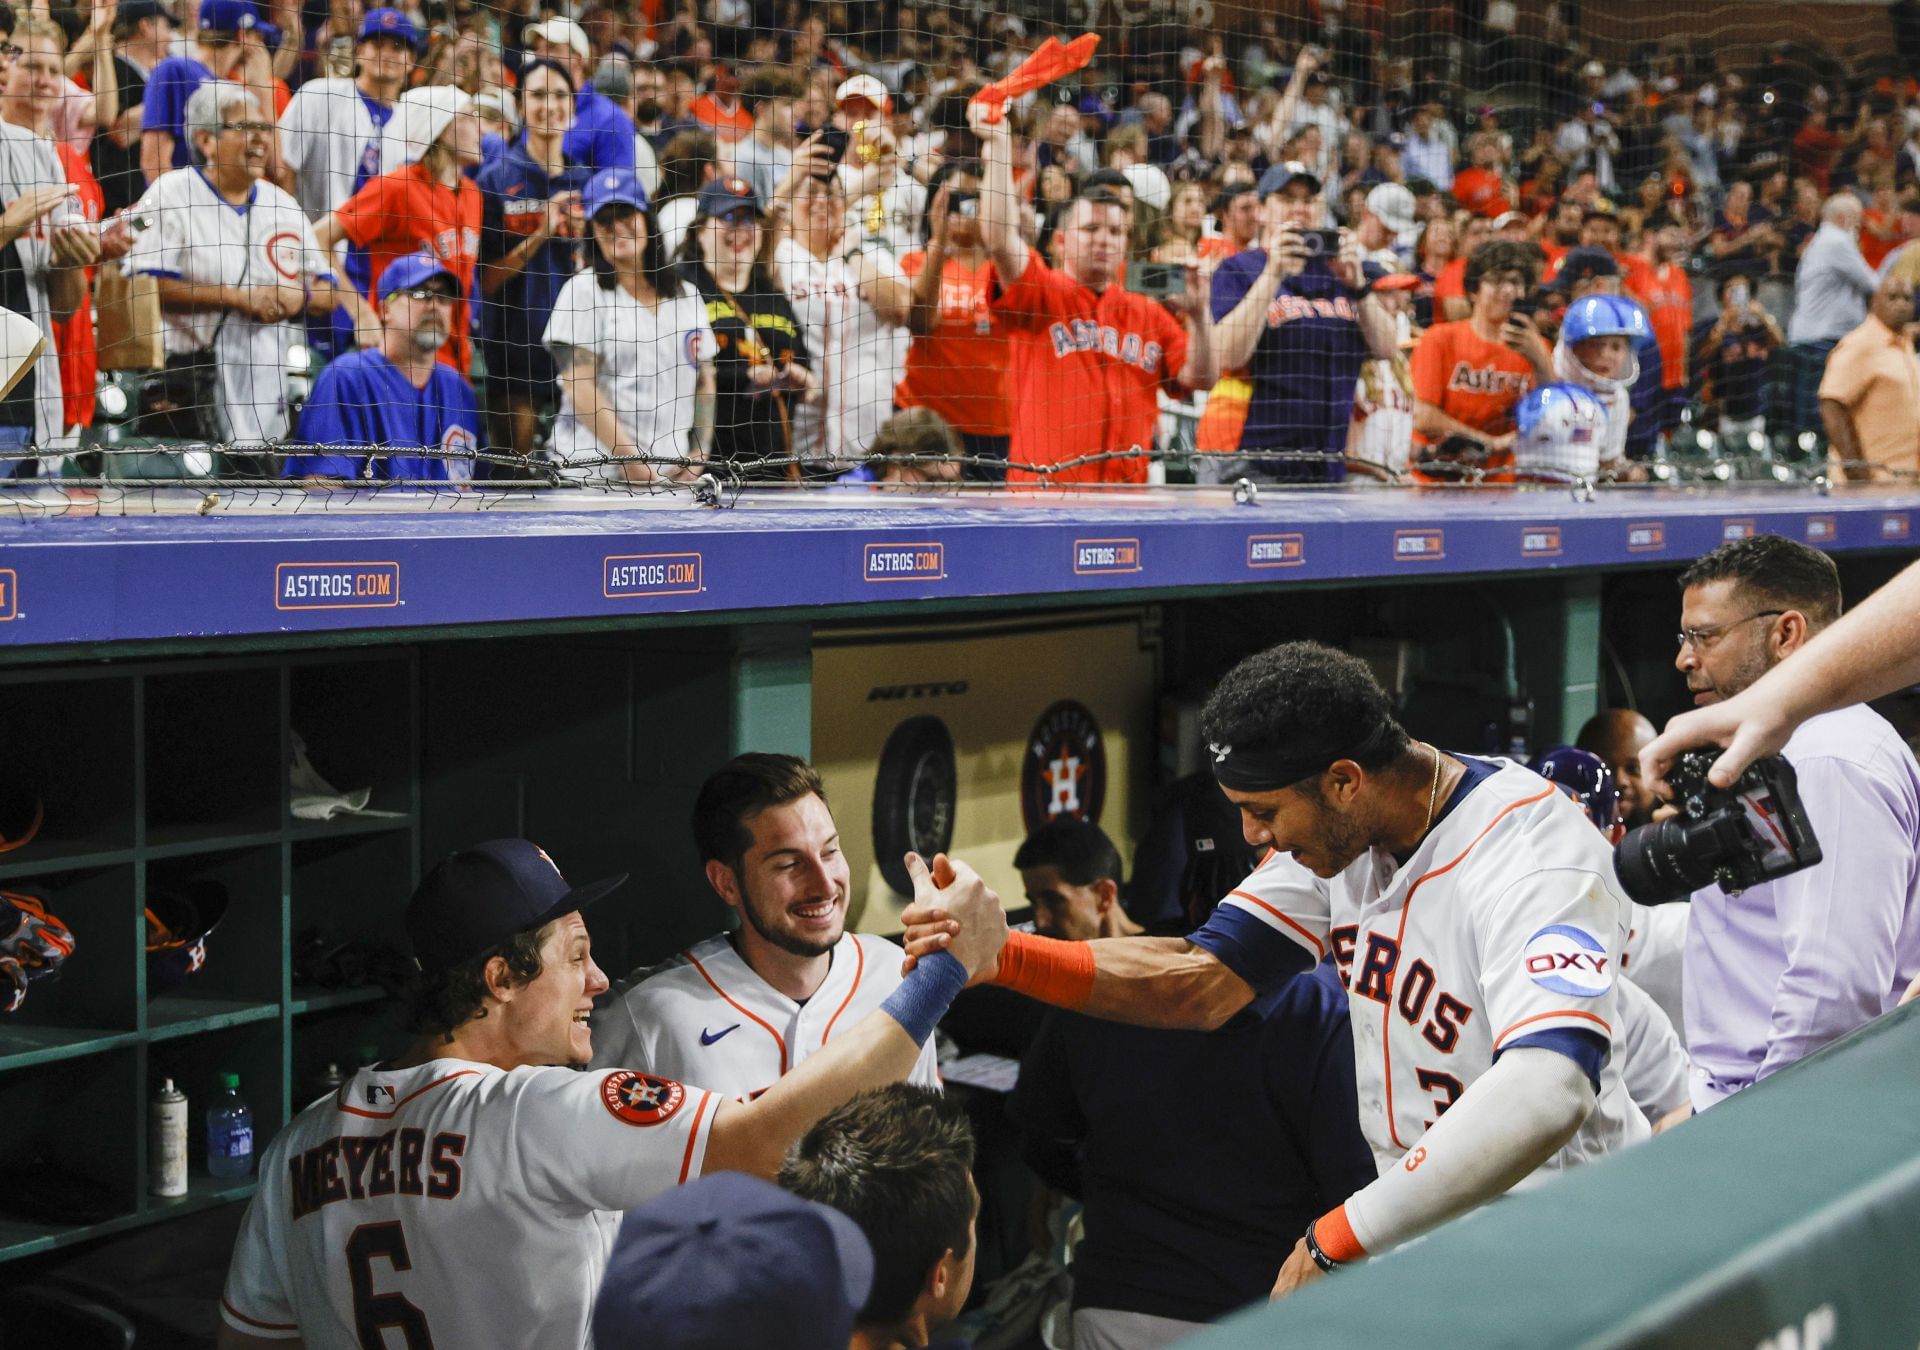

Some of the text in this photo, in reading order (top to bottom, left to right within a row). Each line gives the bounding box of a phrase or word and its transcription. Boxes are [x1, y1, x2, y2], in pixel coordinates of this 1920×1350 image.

[1049, 319, 1162, 374] ASTROS
[870, 552, 938, 571] ASTROS.COM
[285, 574, 391, 597] ASTROS.COM
[611, 564, 695, 587] ASTROS.COM
[866, 681, 969, 702] NITTO
[1525, 952, 1609, 975] OXY
[606, 1071, 636, 1111] HOUSTON
[657, 1081, 682, 1118] ASTROS
[1405, 1146, 1427, 1172] 3
[288, 1127, 467, 1222] MEYERS
[345, 1219, 435, 1350] 6
